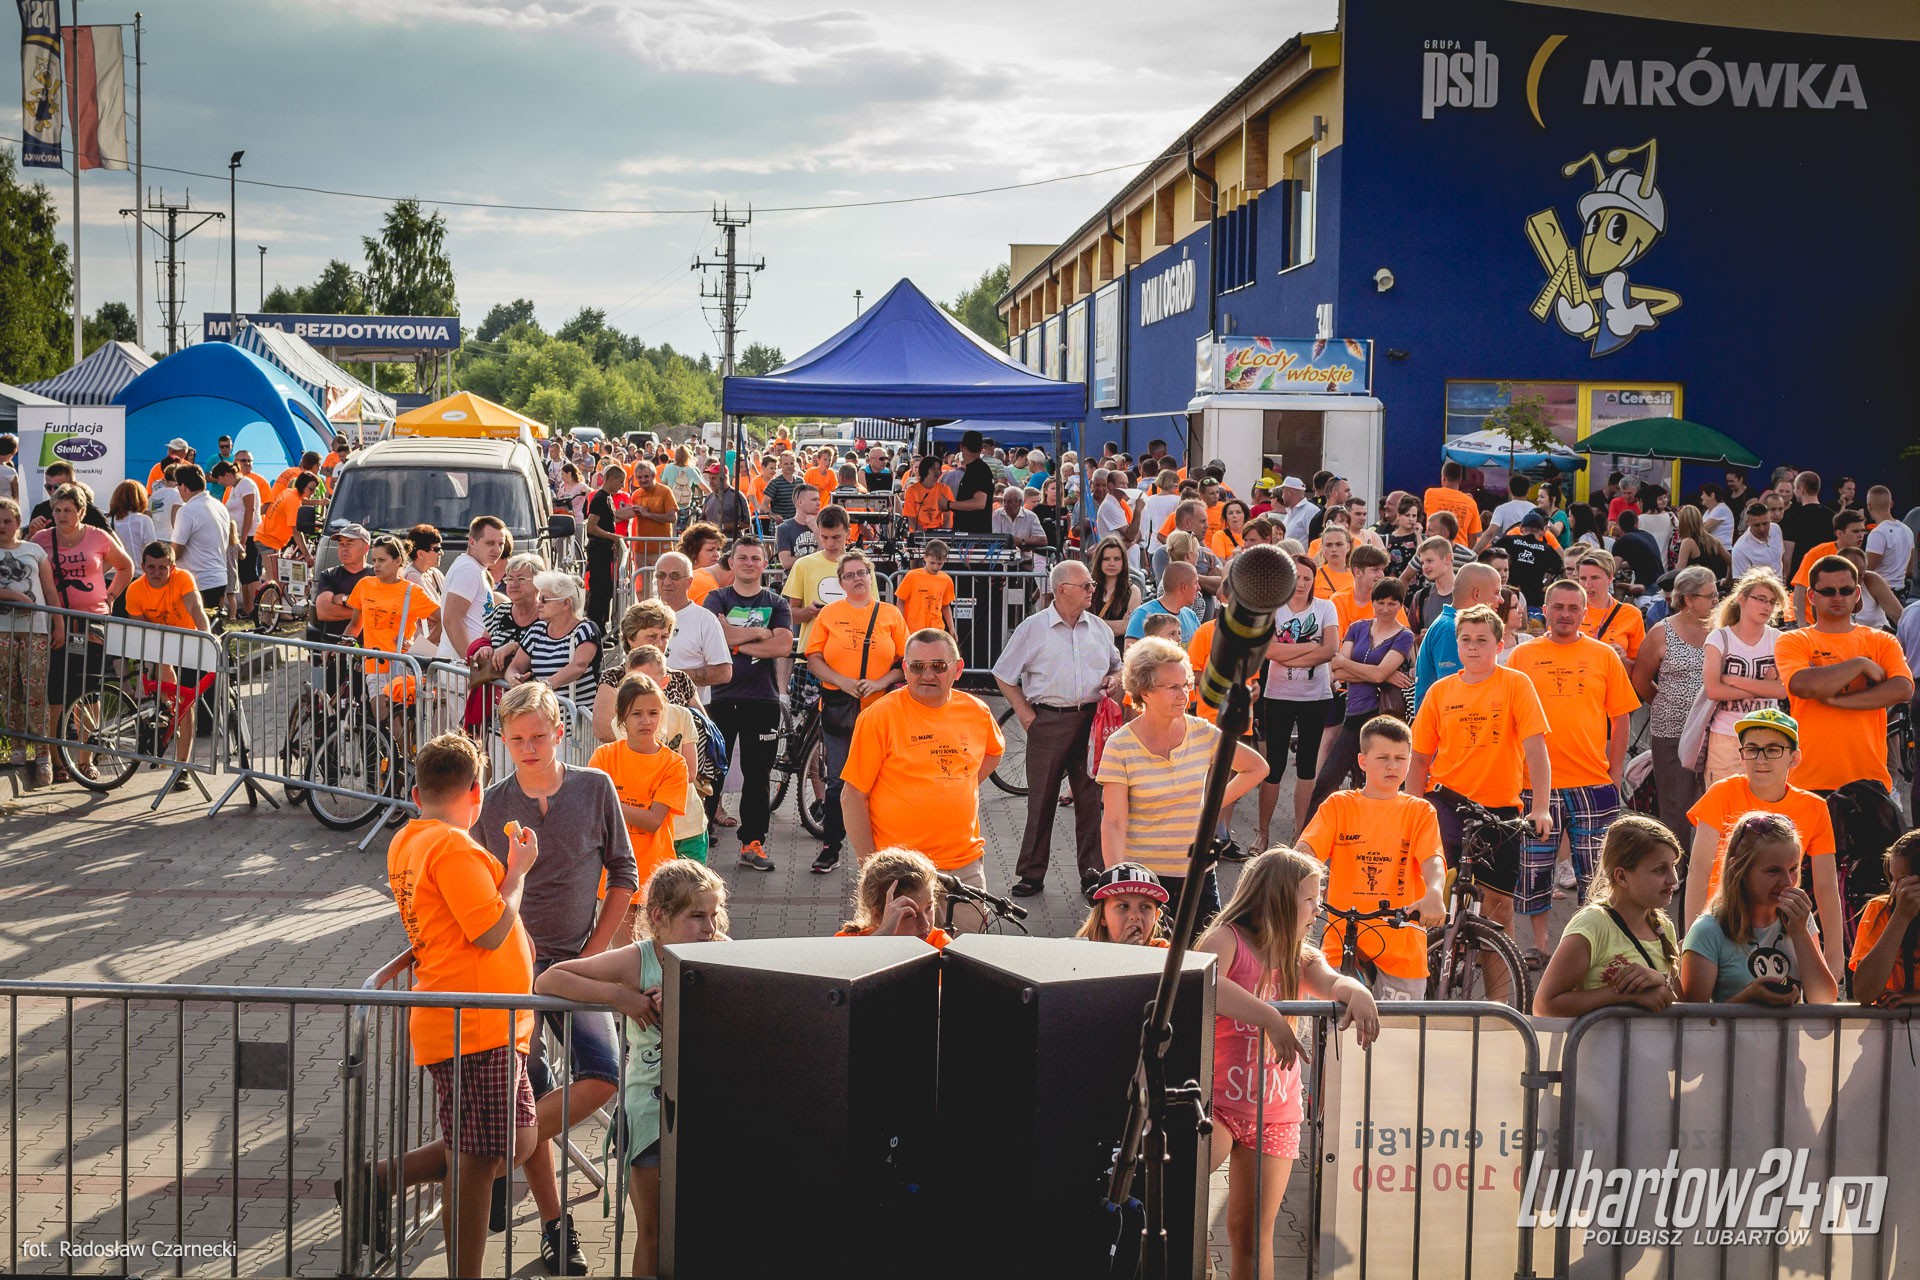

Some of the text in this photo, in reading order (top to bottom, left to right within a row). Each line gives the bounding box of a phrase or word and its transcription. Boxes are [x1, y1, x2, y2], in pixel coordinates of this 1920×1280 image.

[1424, 39, 1461, 50] GRUPA
[1422, 40, 1499, 119] psb
[1582, 47, 1868, 110] MRÓWKA
[1163, 246, 1196, 318] OGRÓD
[295, 323, 450, 341] BEZDOTYKOWA
[1238, 348, 1298, 372] Lody
[1286, 364, 1353, 384] włoskie
[1621, 391, 1672, 404] Ceresit
[44, 422, 103, 436] Fundacja
[56, 445, 82, 454] Stella
[73, 467, 103, 475] rłowskiej
[759, 733, 777, 741] PUMA
[1102, 886, 1164, 898] FABULOUS
[1225, 1065, 1290, 1104] SUN
